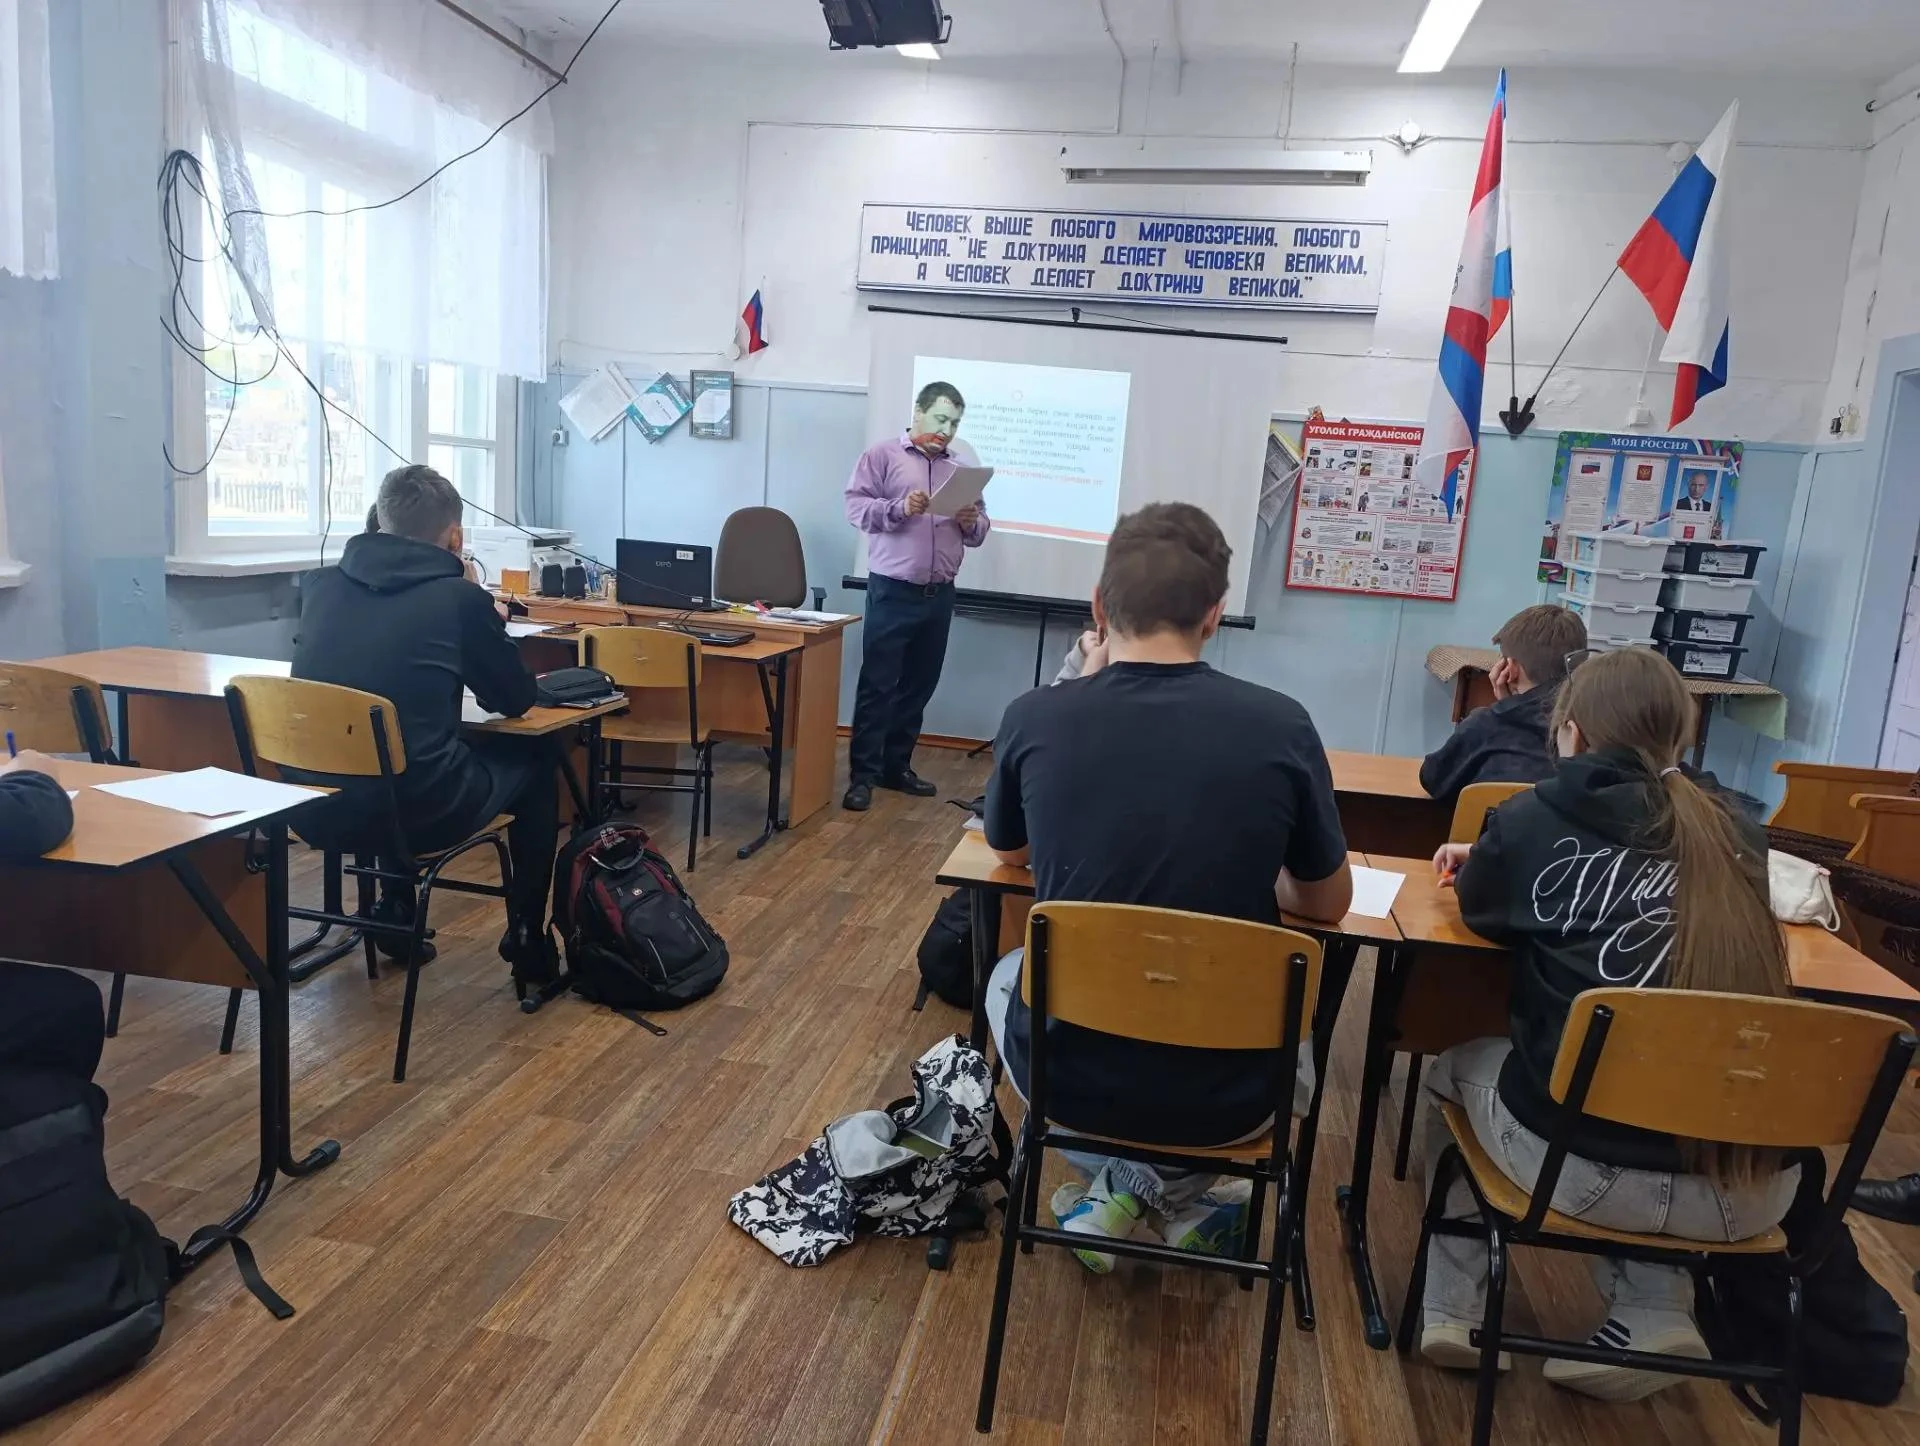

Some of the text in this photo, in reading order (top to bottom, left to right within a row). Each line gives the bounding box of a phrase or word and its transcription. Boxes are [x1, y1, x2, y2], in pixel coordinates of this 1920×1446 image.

[906, 210, 972, 234] ЧЕЛОВЕК
[983, 215, 1033, 237] ВЫШЕ
[1050, 218, 1116, 240] ЛЮБОГО
[1293, 227, 1361, 249] ЛЮБОГО
[1002, 241, 1087, 264] ДОКТРИНА
[1100, 245, 1167, 267] ДЕЛАЕТ
[1184, 248, 1266, 272] ЧЕЛОВЕКА
[1284, 252, 1368, 277] ВЕЛИКИМ,
[917, 261, 928, 281] А
[945, 263, 1012, 285] ЧЕЛОВЕК
[1030, 267, 1096, 289] ДЕЛАЕТ
[1117, 272, 1204, 294] ДОКТРИНУ
[1308, 425, 1422, 441] УГОЛОК ГРАЖДАНСКОЙ
[1610, 437, 1689, 450] МОЯ РОССИЯ
